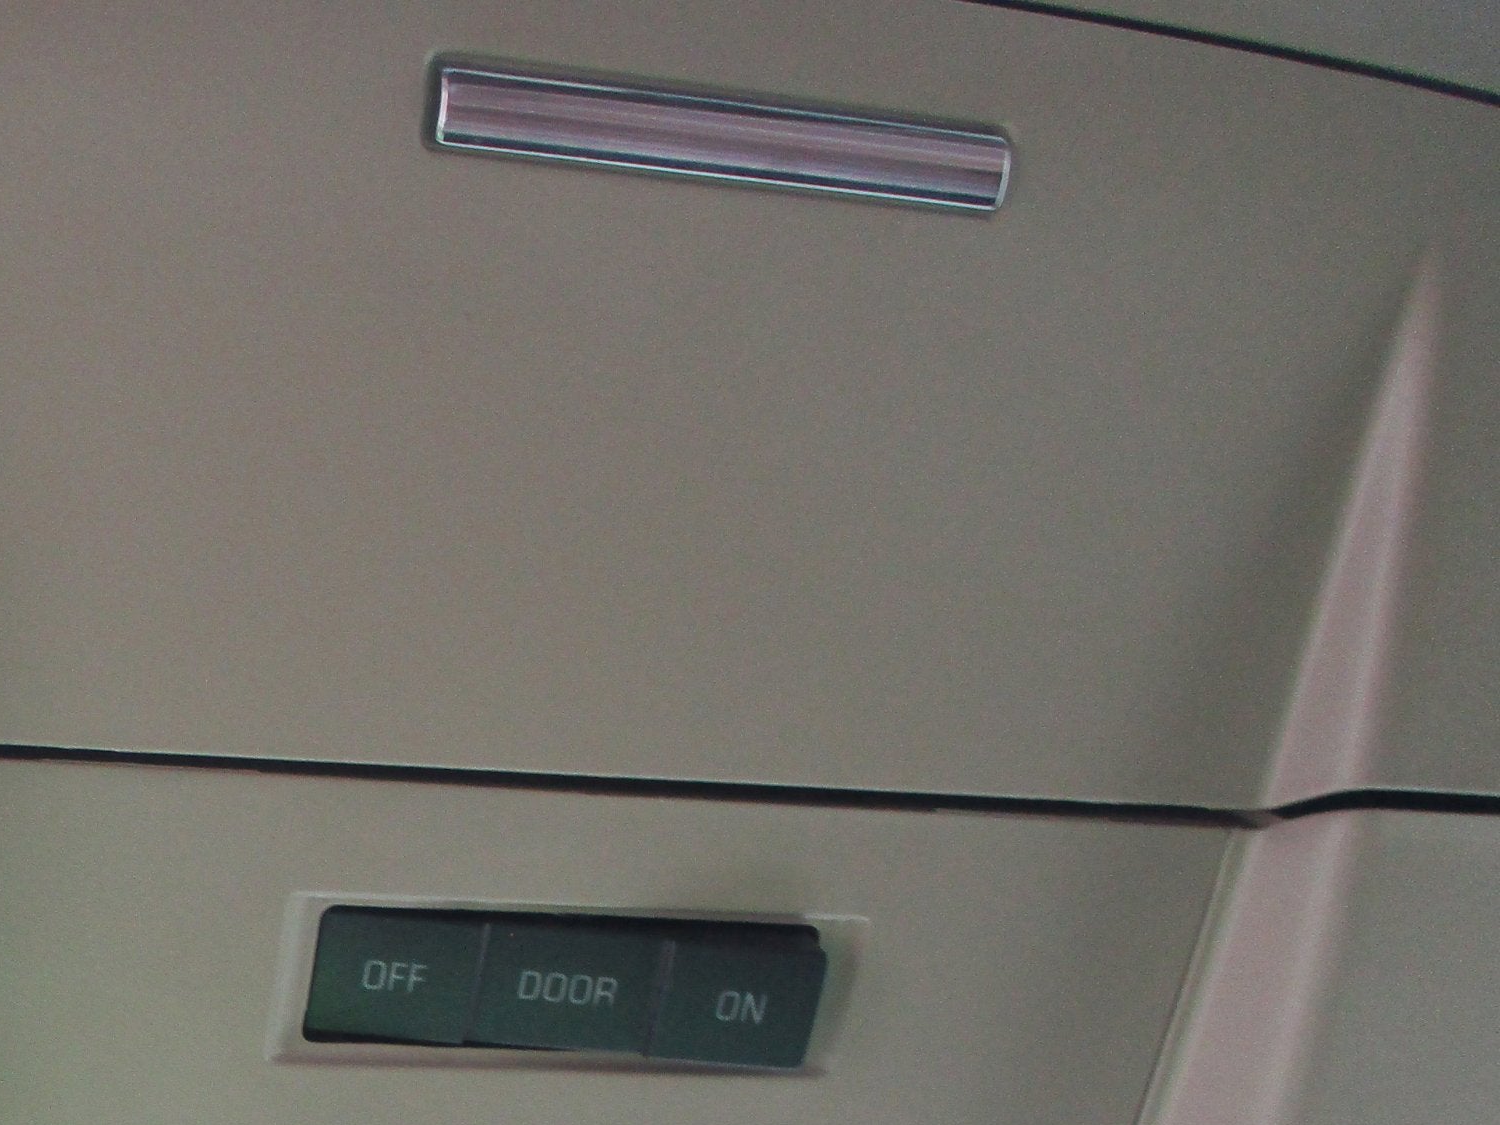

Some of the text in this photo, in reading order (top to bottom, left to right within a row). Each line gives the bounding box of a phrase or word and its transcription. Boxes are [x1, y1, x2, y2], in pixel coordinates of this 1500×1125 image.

[361, 960, 427, 992] OFF
[517, 969, 618, 1006] DOOR
[715, 990, 767, 1024] ON
